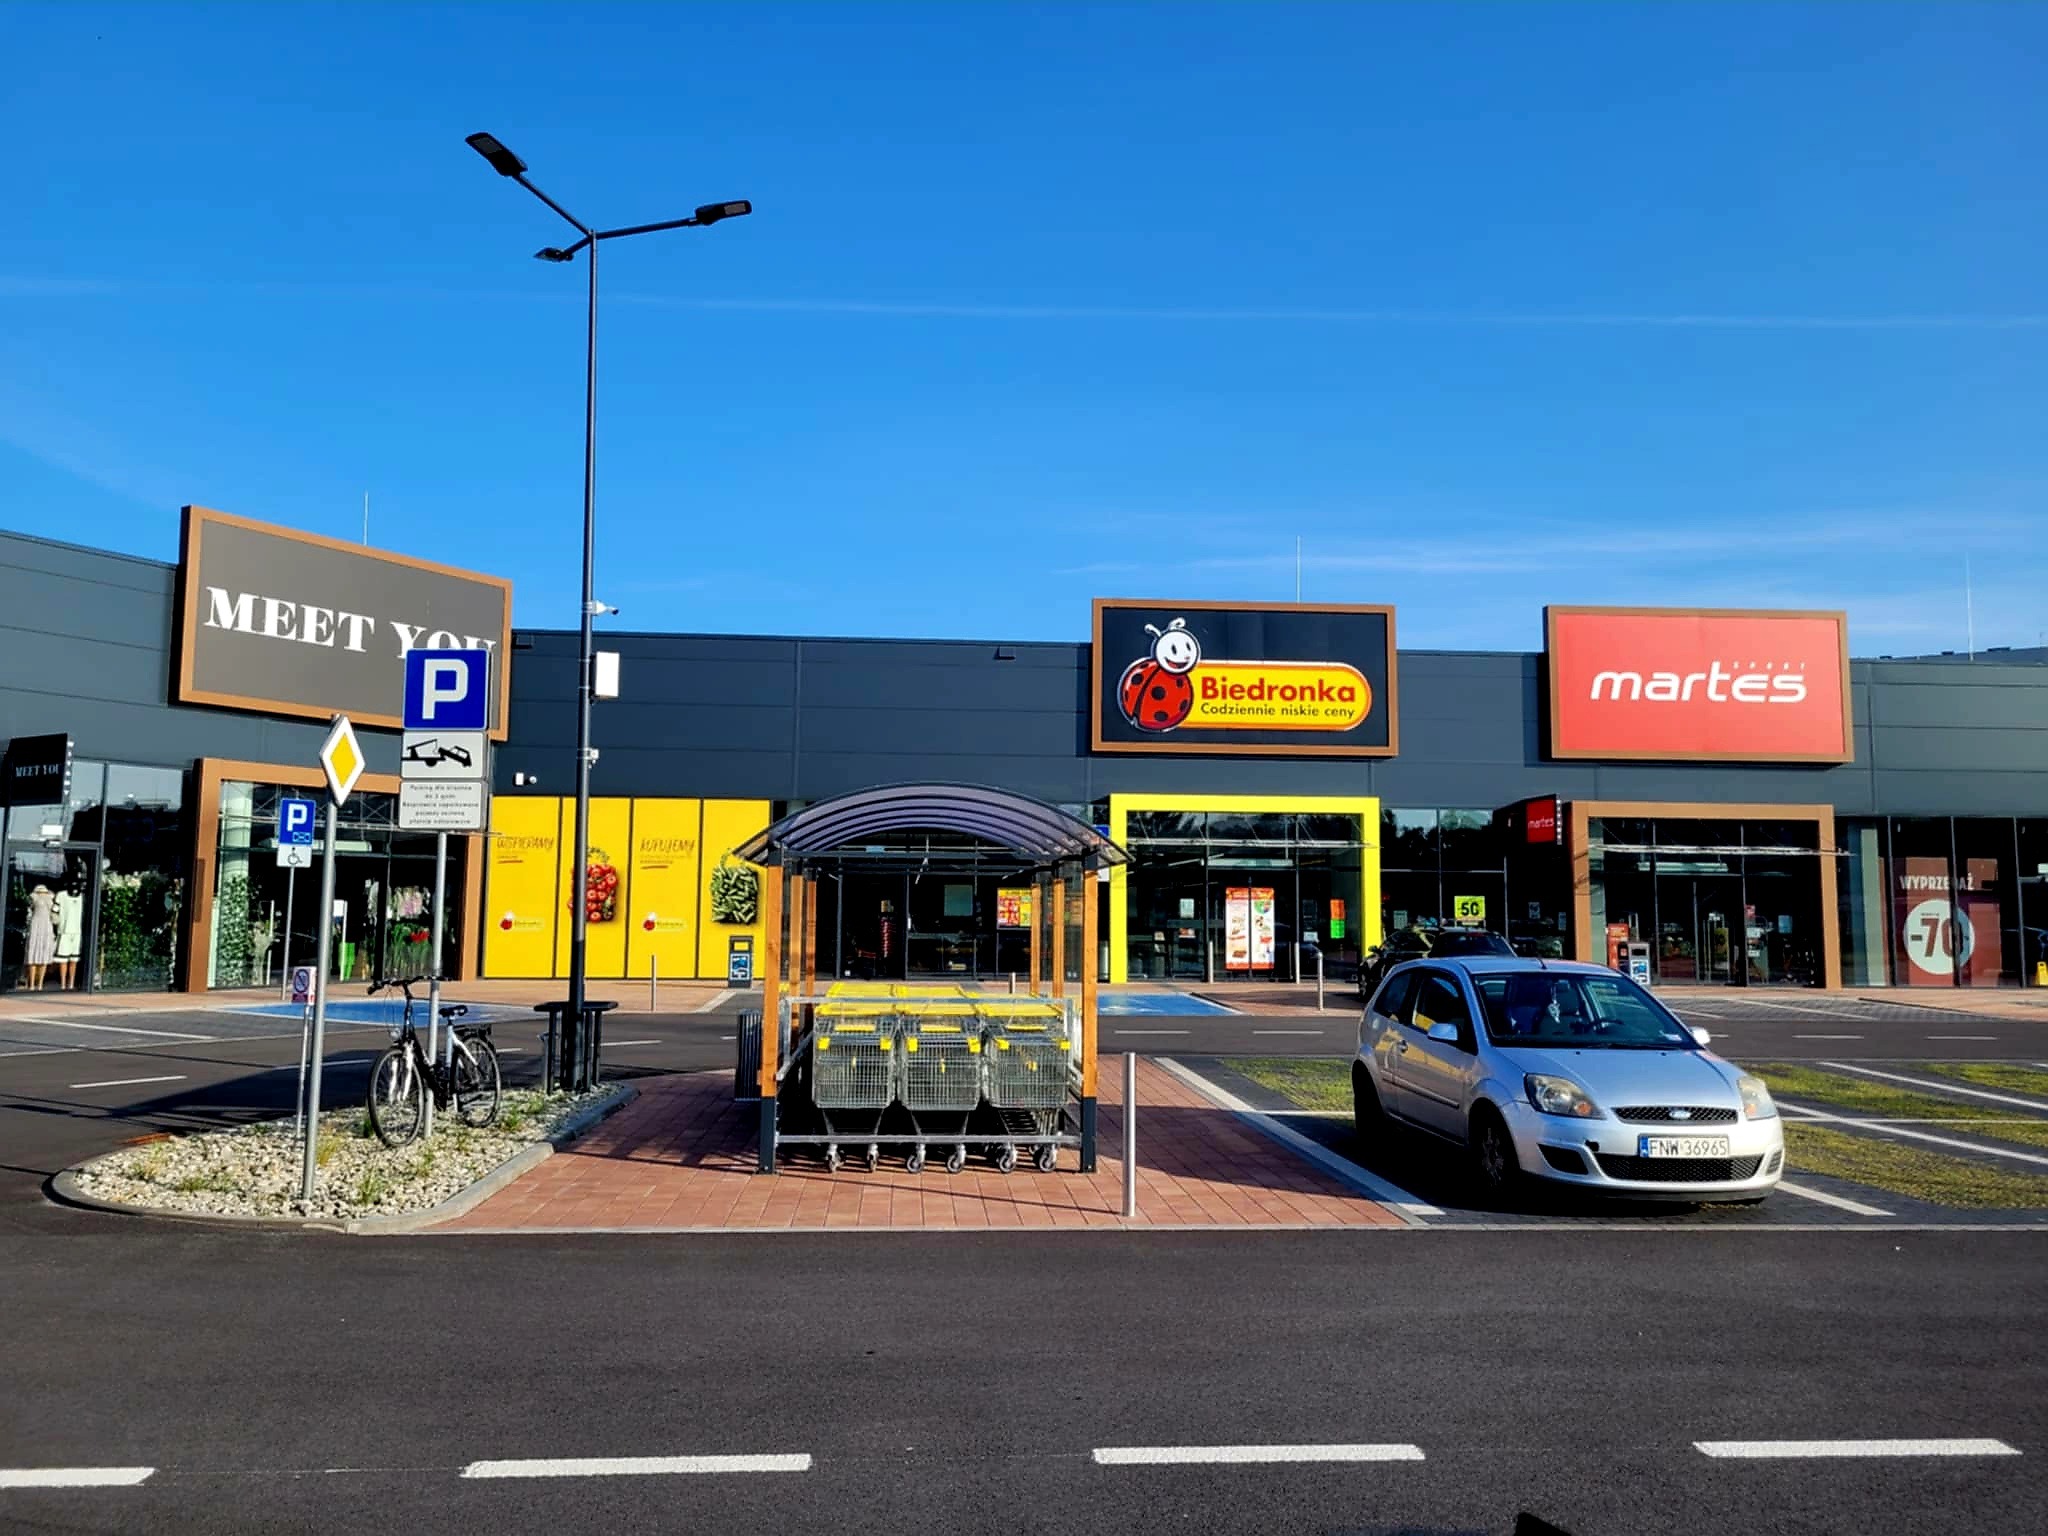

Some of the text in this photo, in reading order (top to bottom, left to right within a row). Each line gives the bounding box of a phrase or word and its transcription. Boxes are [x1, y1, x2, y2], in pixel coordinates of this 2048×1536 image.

[204, 586, 375, 653] MEET
[421, 658, 469, 720] P
[1201, 676, 1355, 702] Biedronka
[1590, 660, 1807, 703] martes
[1200, 703, 1355, 719] Codziennie niskie ceny
[286, 803, 308, 832] P
[1650, 1140, 1728, 1156] FNW 36965
